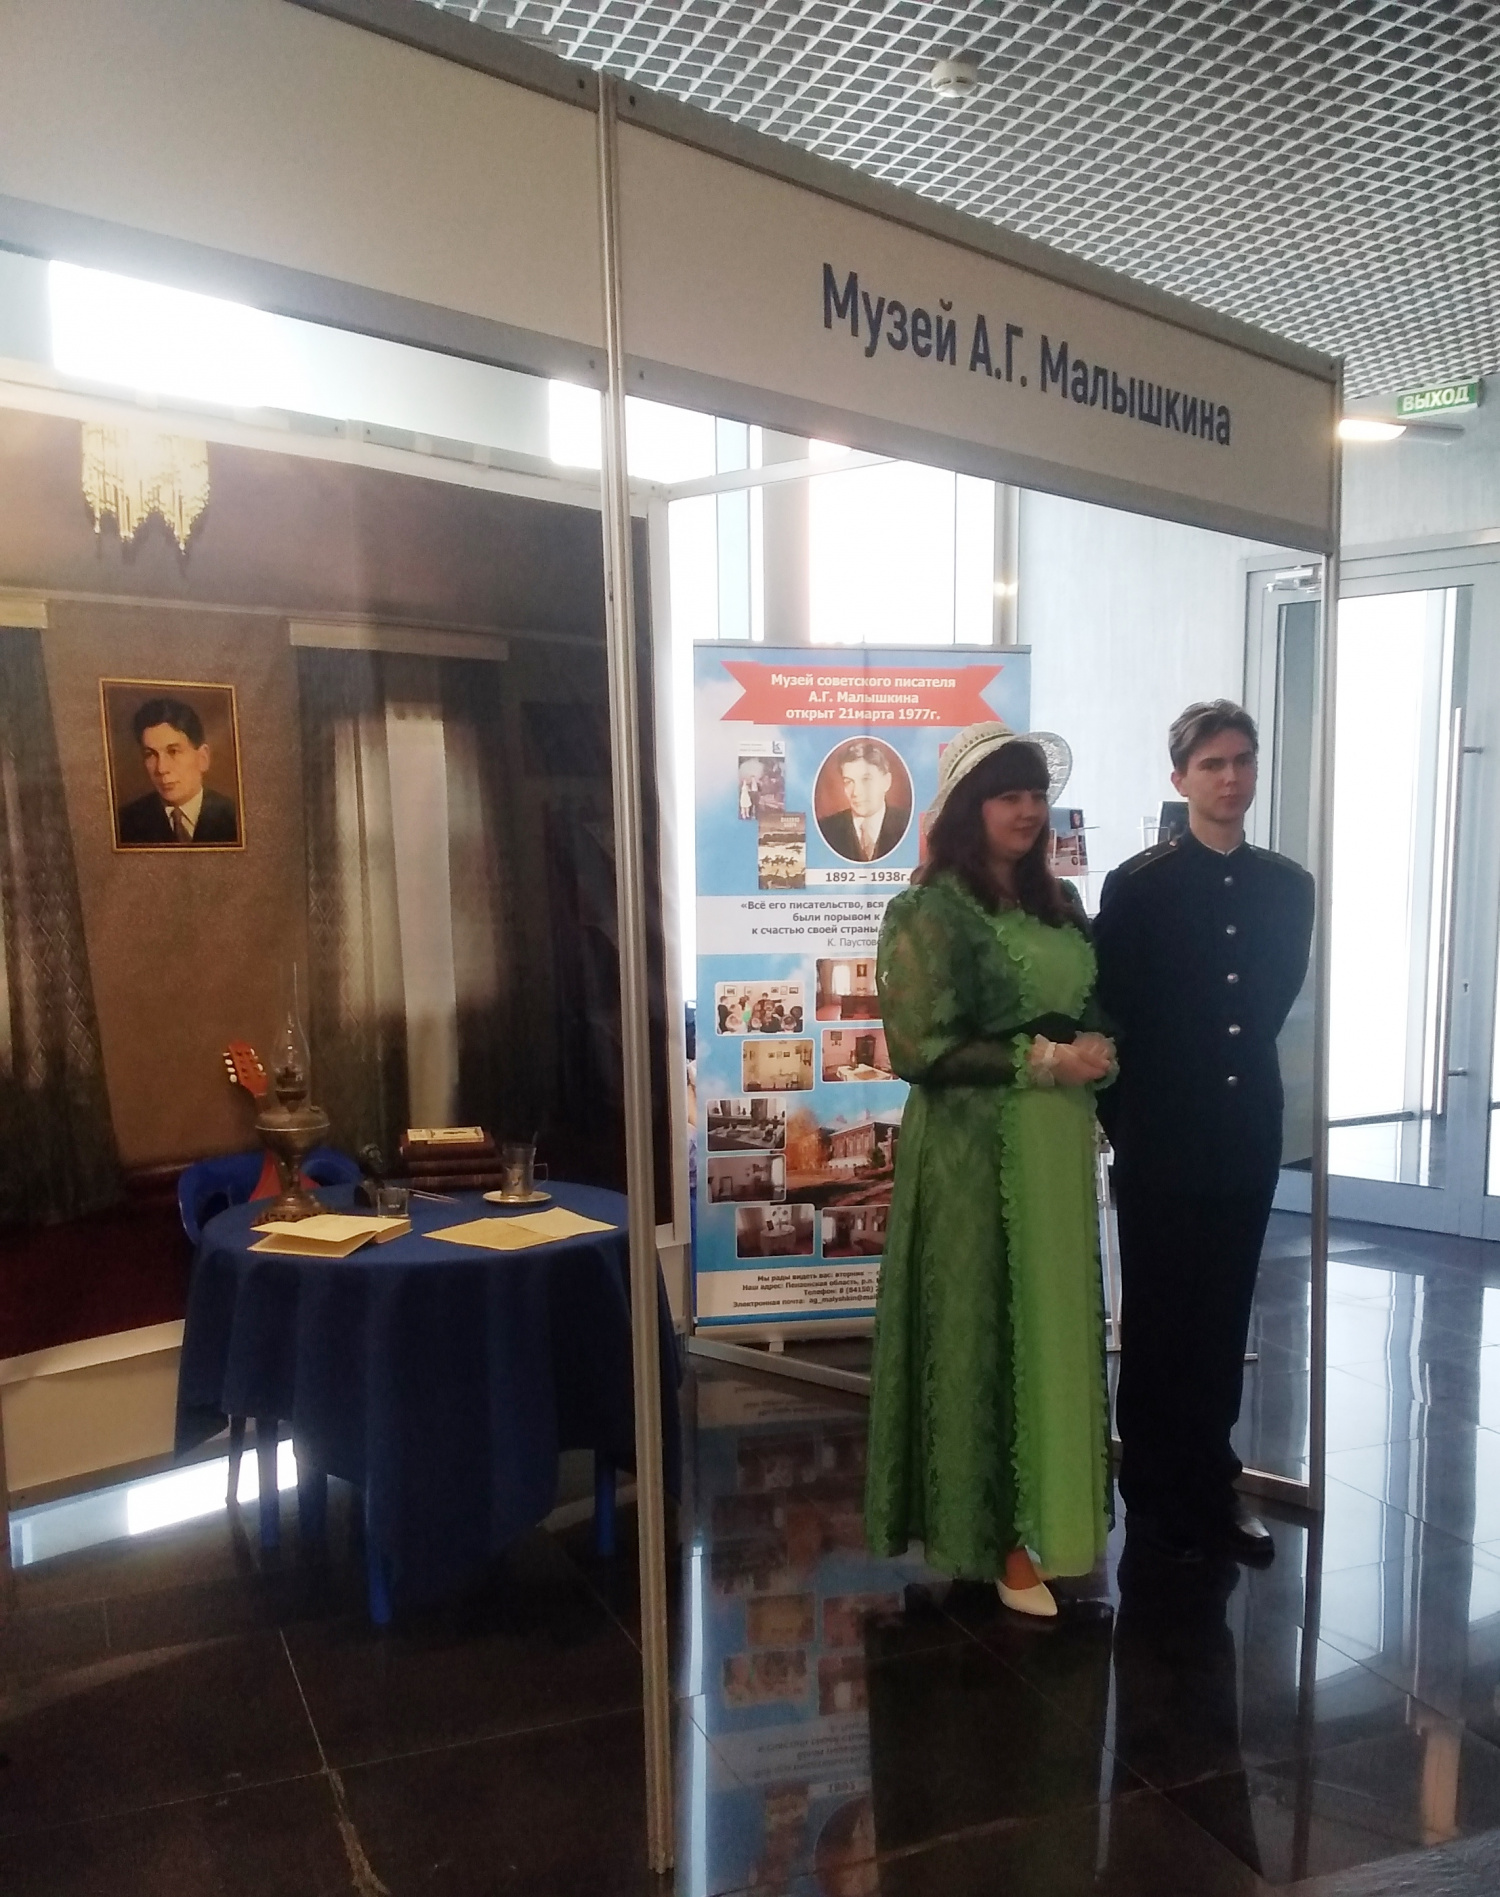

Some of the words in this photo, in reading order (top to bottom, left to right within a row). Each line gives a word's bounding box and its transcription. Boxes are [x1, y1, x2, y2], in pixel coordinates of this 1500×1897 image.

[822, 262, 957, 366] Музей
[969, 313, 1028, 387] А.Г.
[1040, 334, 1231, 446] Малышкина
[1402, 385, 1470, 412] ВЫХОД
[771, 673, 814, 688] Музей
[816, 676, 891, 689] советского
[894, 677, 956, 688] писателя
[808, 691, 833, 703] А.Г.
[837, 691, 919, 704] Малышкина
[785, 709, 835, 722] открыт
[838, 708, 895, 722] 21марта
[898, 708, 941, 720] 1977г.
[825, 872, 856, 882] 1892
[870, 871, 910, 882] 1938г.
[740, 901, 766, 910] «Всё
[768, 902, 787, 910] его
[789, 901, 864, 910] писательство,
[792, 913, 821, 921] были
[824, 914, 871, 923] порывом
[760, 926, 805, 934] счастью
[807, 924, 838, 934] своей
[827, 938, 837, 946] К.
[732, 1300, 780, 1308] Электронная
